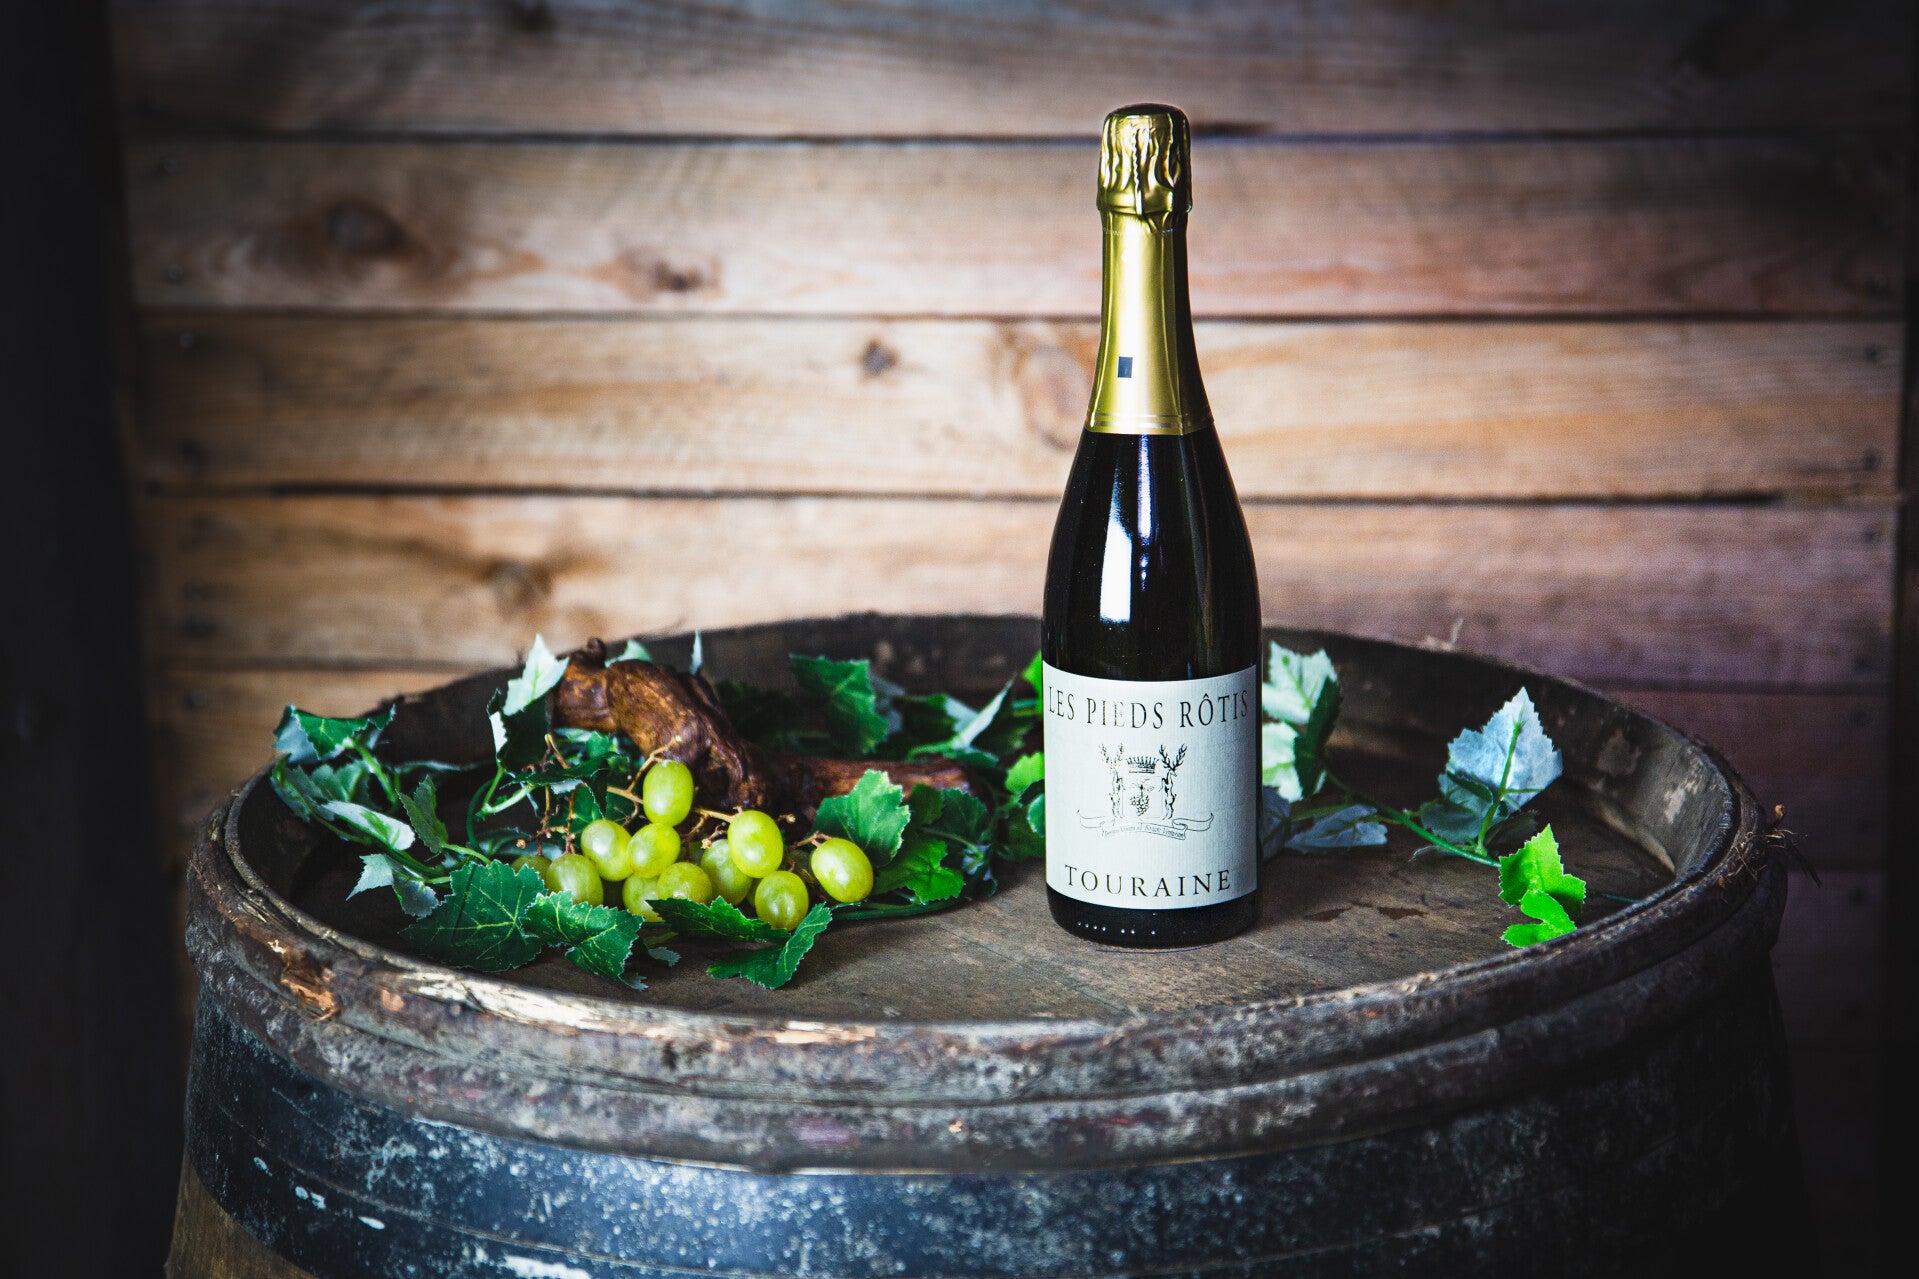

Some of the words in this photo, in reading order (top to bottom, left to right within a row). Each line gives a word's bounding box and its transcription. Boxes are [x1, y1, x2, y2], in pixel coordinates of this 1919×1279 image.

[1049, 686, 1075, 721] LES
[1086, 697, 1163, 730] PIEDS
[1180, 689, 1248, 728] RÔTIS
[1064, 864, 1231, 898] TOURAINE
